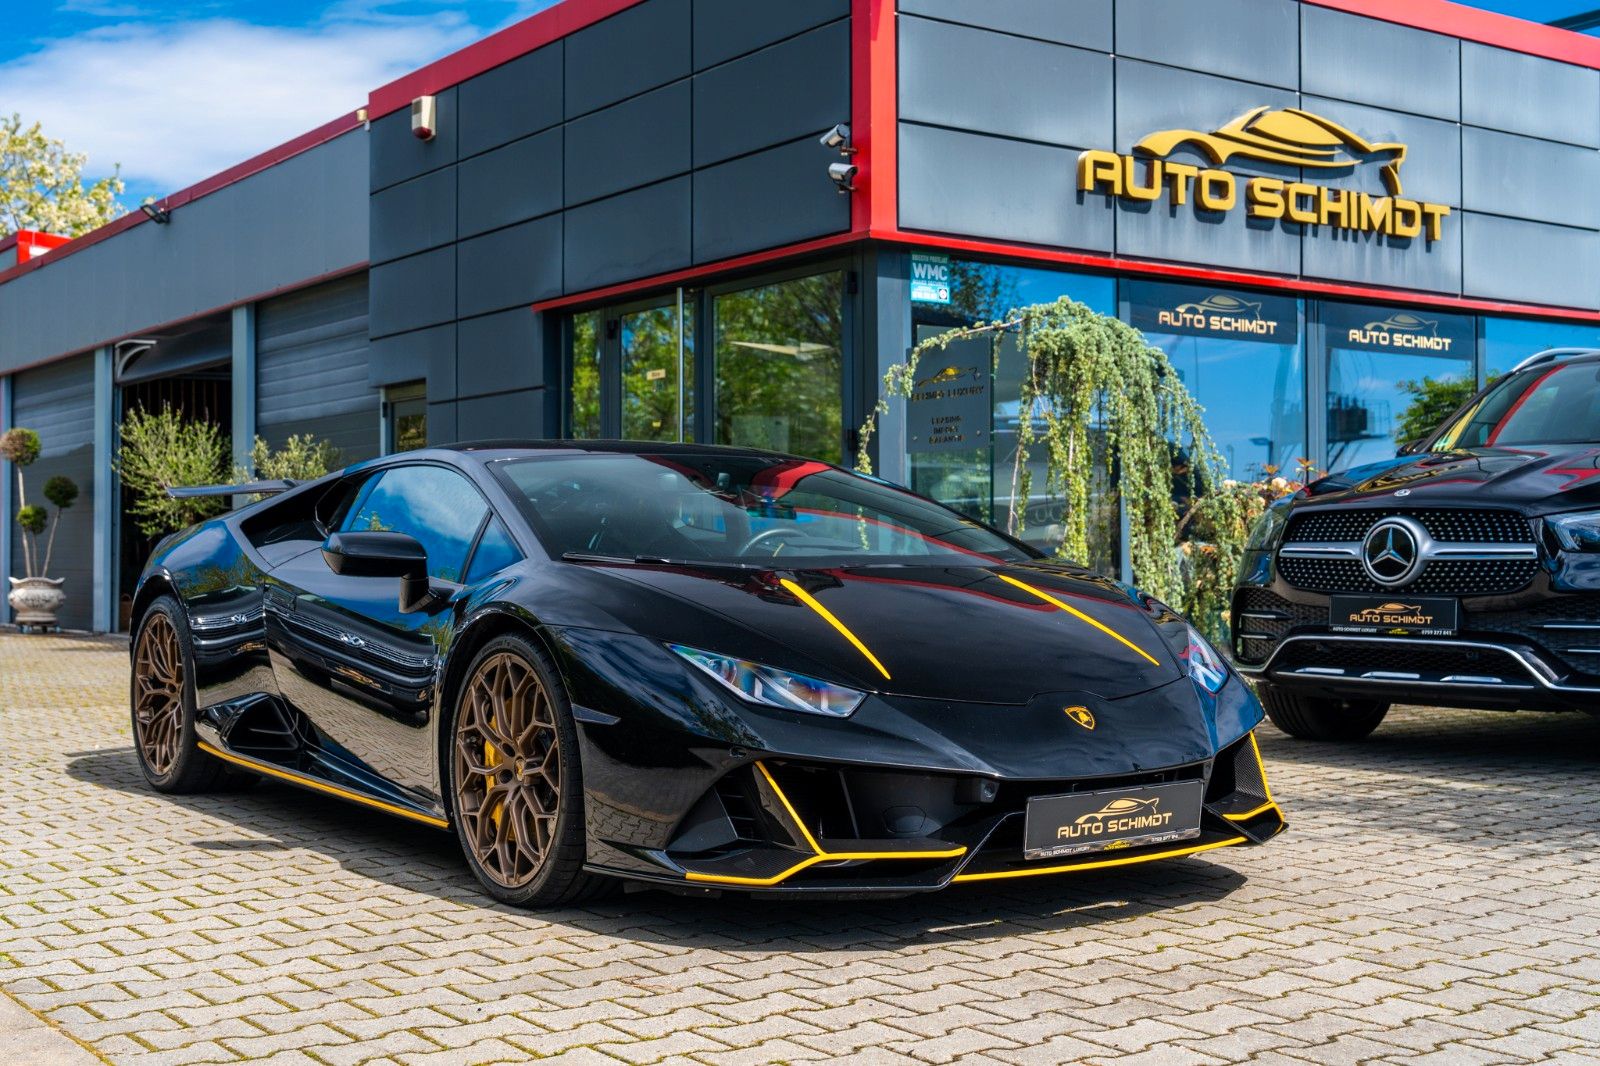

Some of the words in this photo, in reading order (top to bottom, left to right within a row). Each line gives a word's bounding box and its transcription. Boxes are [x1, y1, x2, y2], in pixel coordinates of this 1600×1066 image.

[1077, 150, 1237, 211] AUTO
[1246, 177, 1451, 241] SCHIMDT
[912, 262, 948, 281] WMC
[1158, 311, 1205, 329] AUTO
[1210, 316, 1278, 335] SCHIMDT
[1349, 329, 1390, 345] AUTO
[1393, 333, 1452, 351] SCHIMDT
[1349, 613, 1381, 623] AUTO
[1382, 614, 1433, 624] SCHIMDT
[1057, 821, 1103, 839] AUTO
[1107, 812, 1173, 833] SCHIMDT
